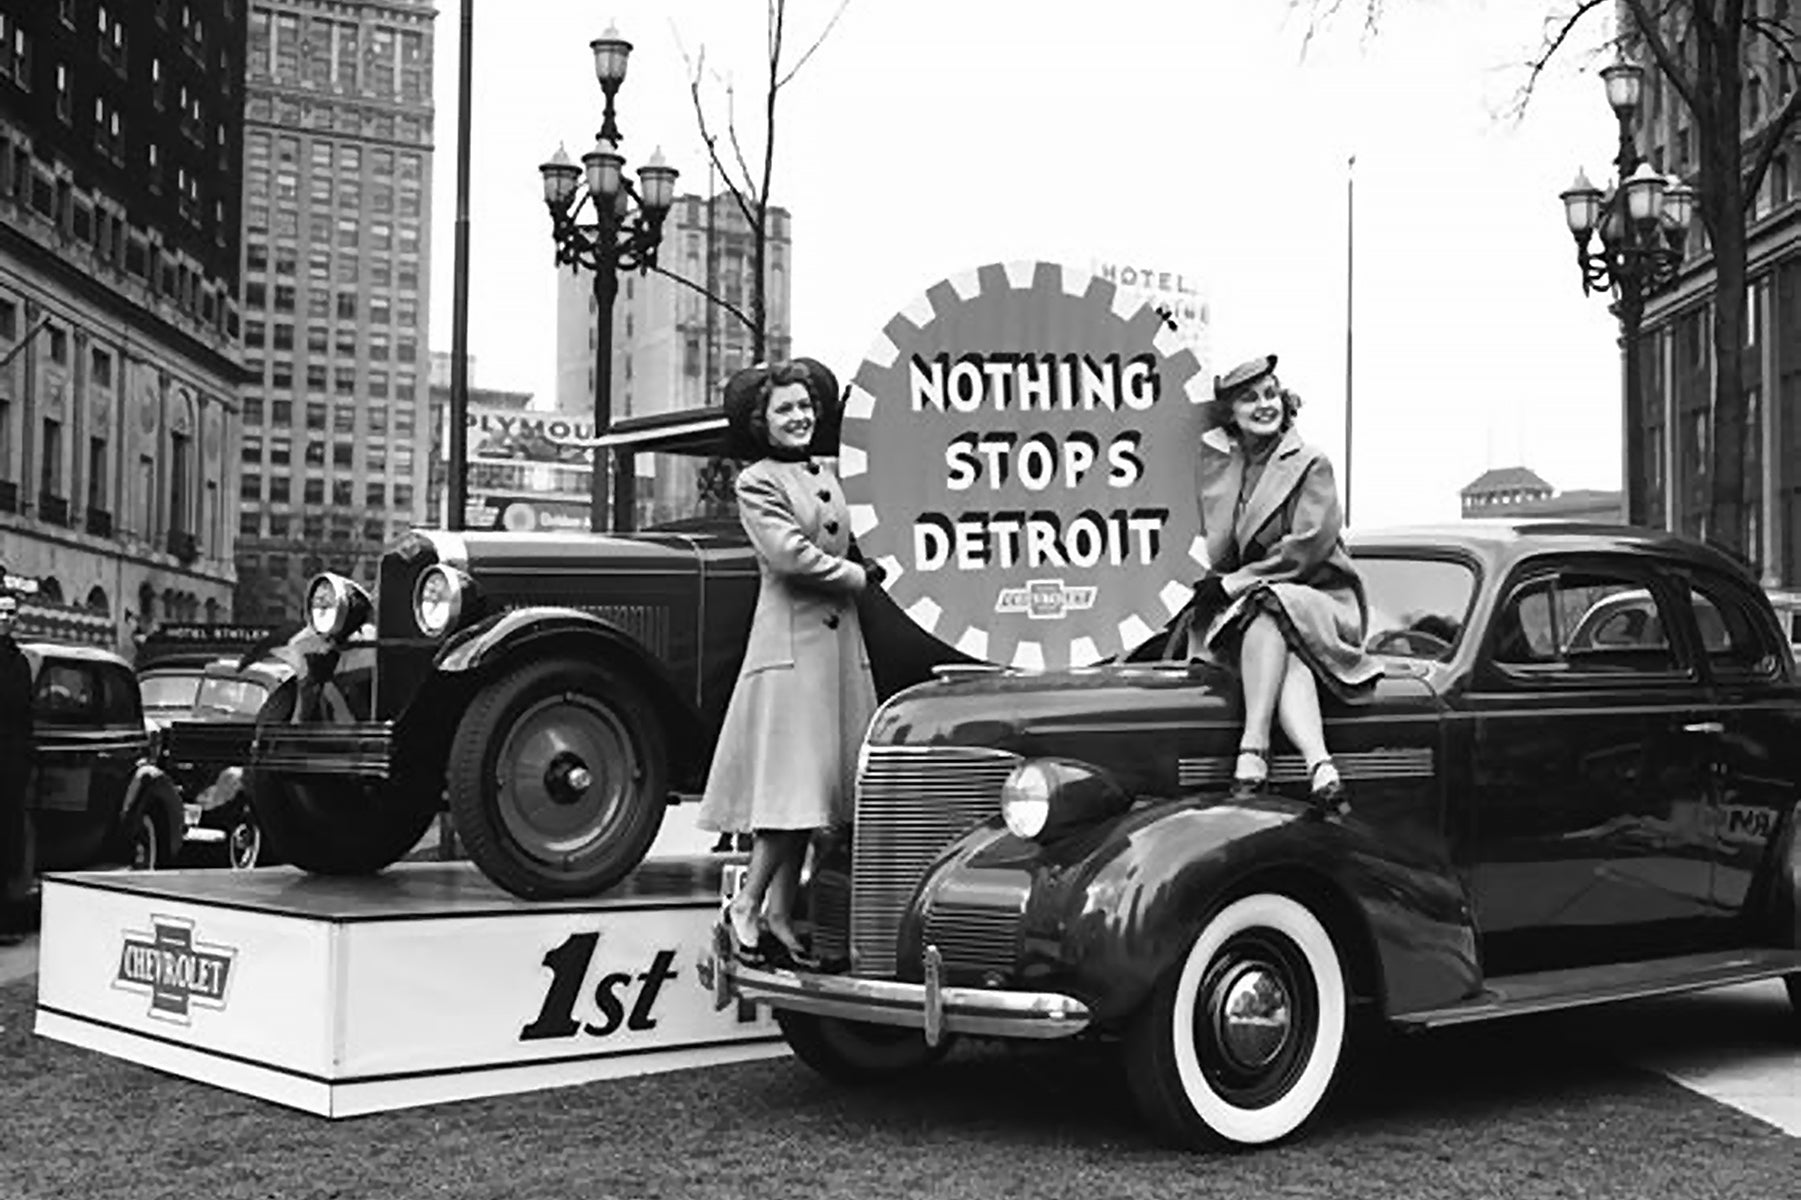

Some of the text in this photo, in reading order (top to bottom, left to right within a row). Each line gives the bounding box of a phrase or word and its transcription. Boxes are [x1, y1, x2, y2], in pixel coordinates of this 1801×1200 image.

[1102, 264, 1197, 294] HOTEL
[909, 352, 1160, 413] NOTHING
[944, 431, 1145, 491] STOPS
[913, 509, 1169, 571] DETROIT
[124, 944, 224, 994] CHEVROLET
[519, 931, 679, 1041] 1st
